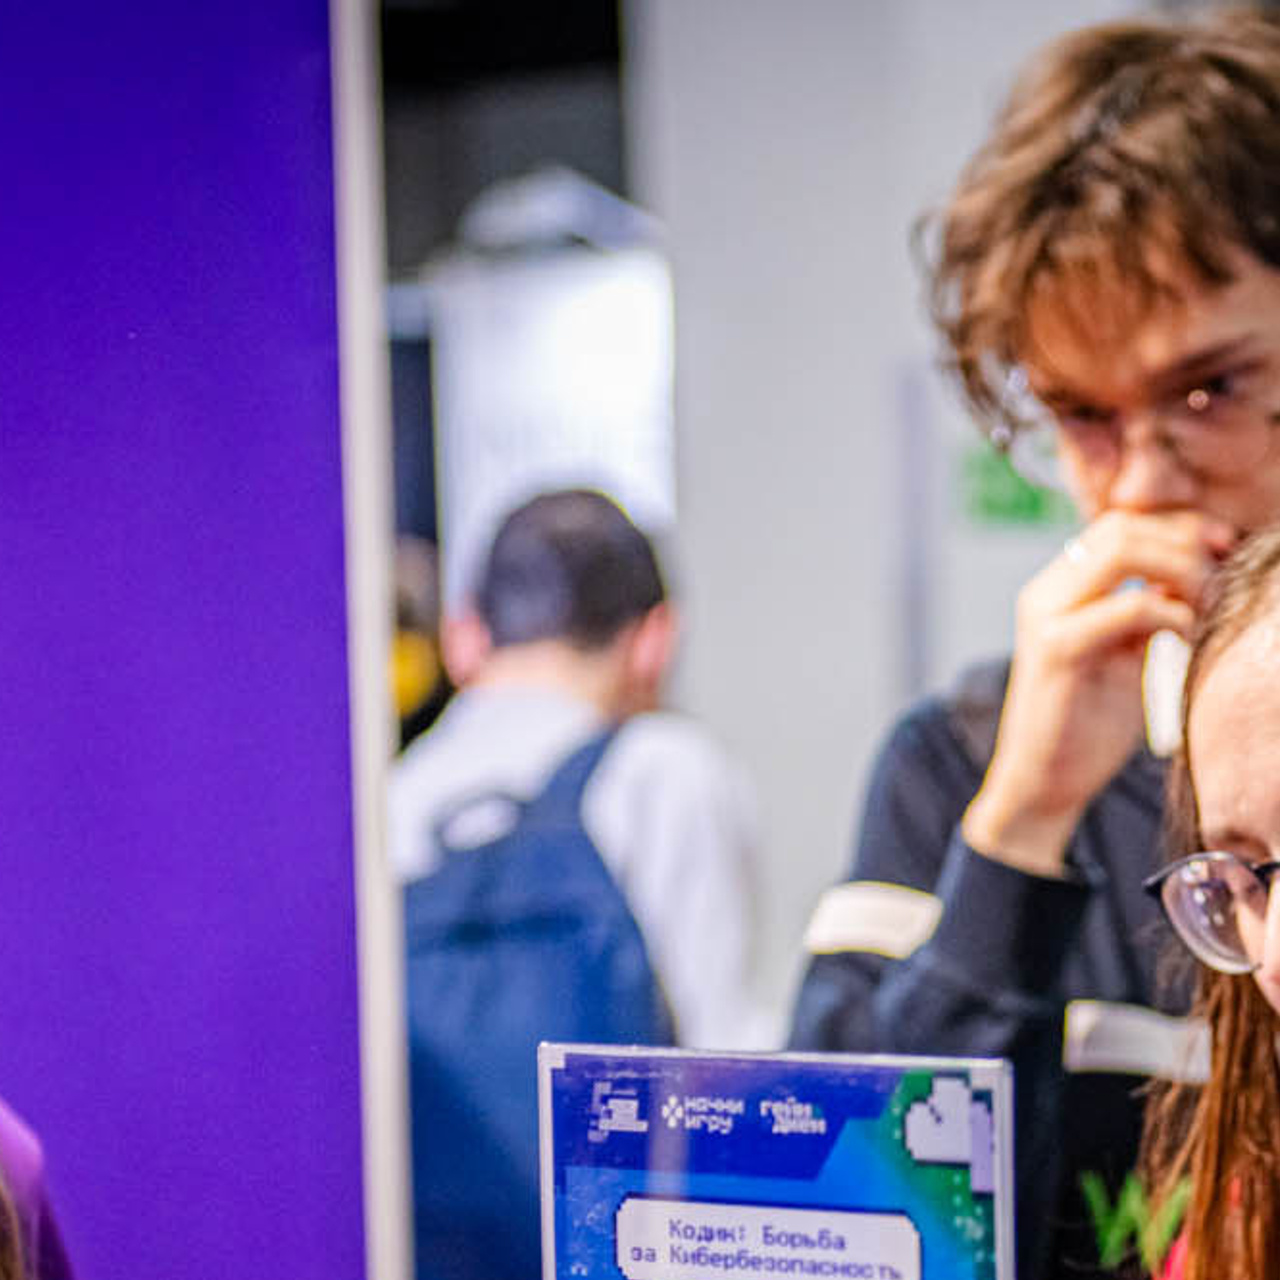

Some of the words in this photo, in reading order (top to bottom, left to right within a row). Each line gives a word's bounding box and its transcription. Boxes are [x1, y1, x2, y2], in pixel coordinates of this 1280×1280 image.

[668, 1219, 745, 1243] Кодик:
[762, 1225, 846, 1251] Борьба
[631, 1246, 656, 1263] за
